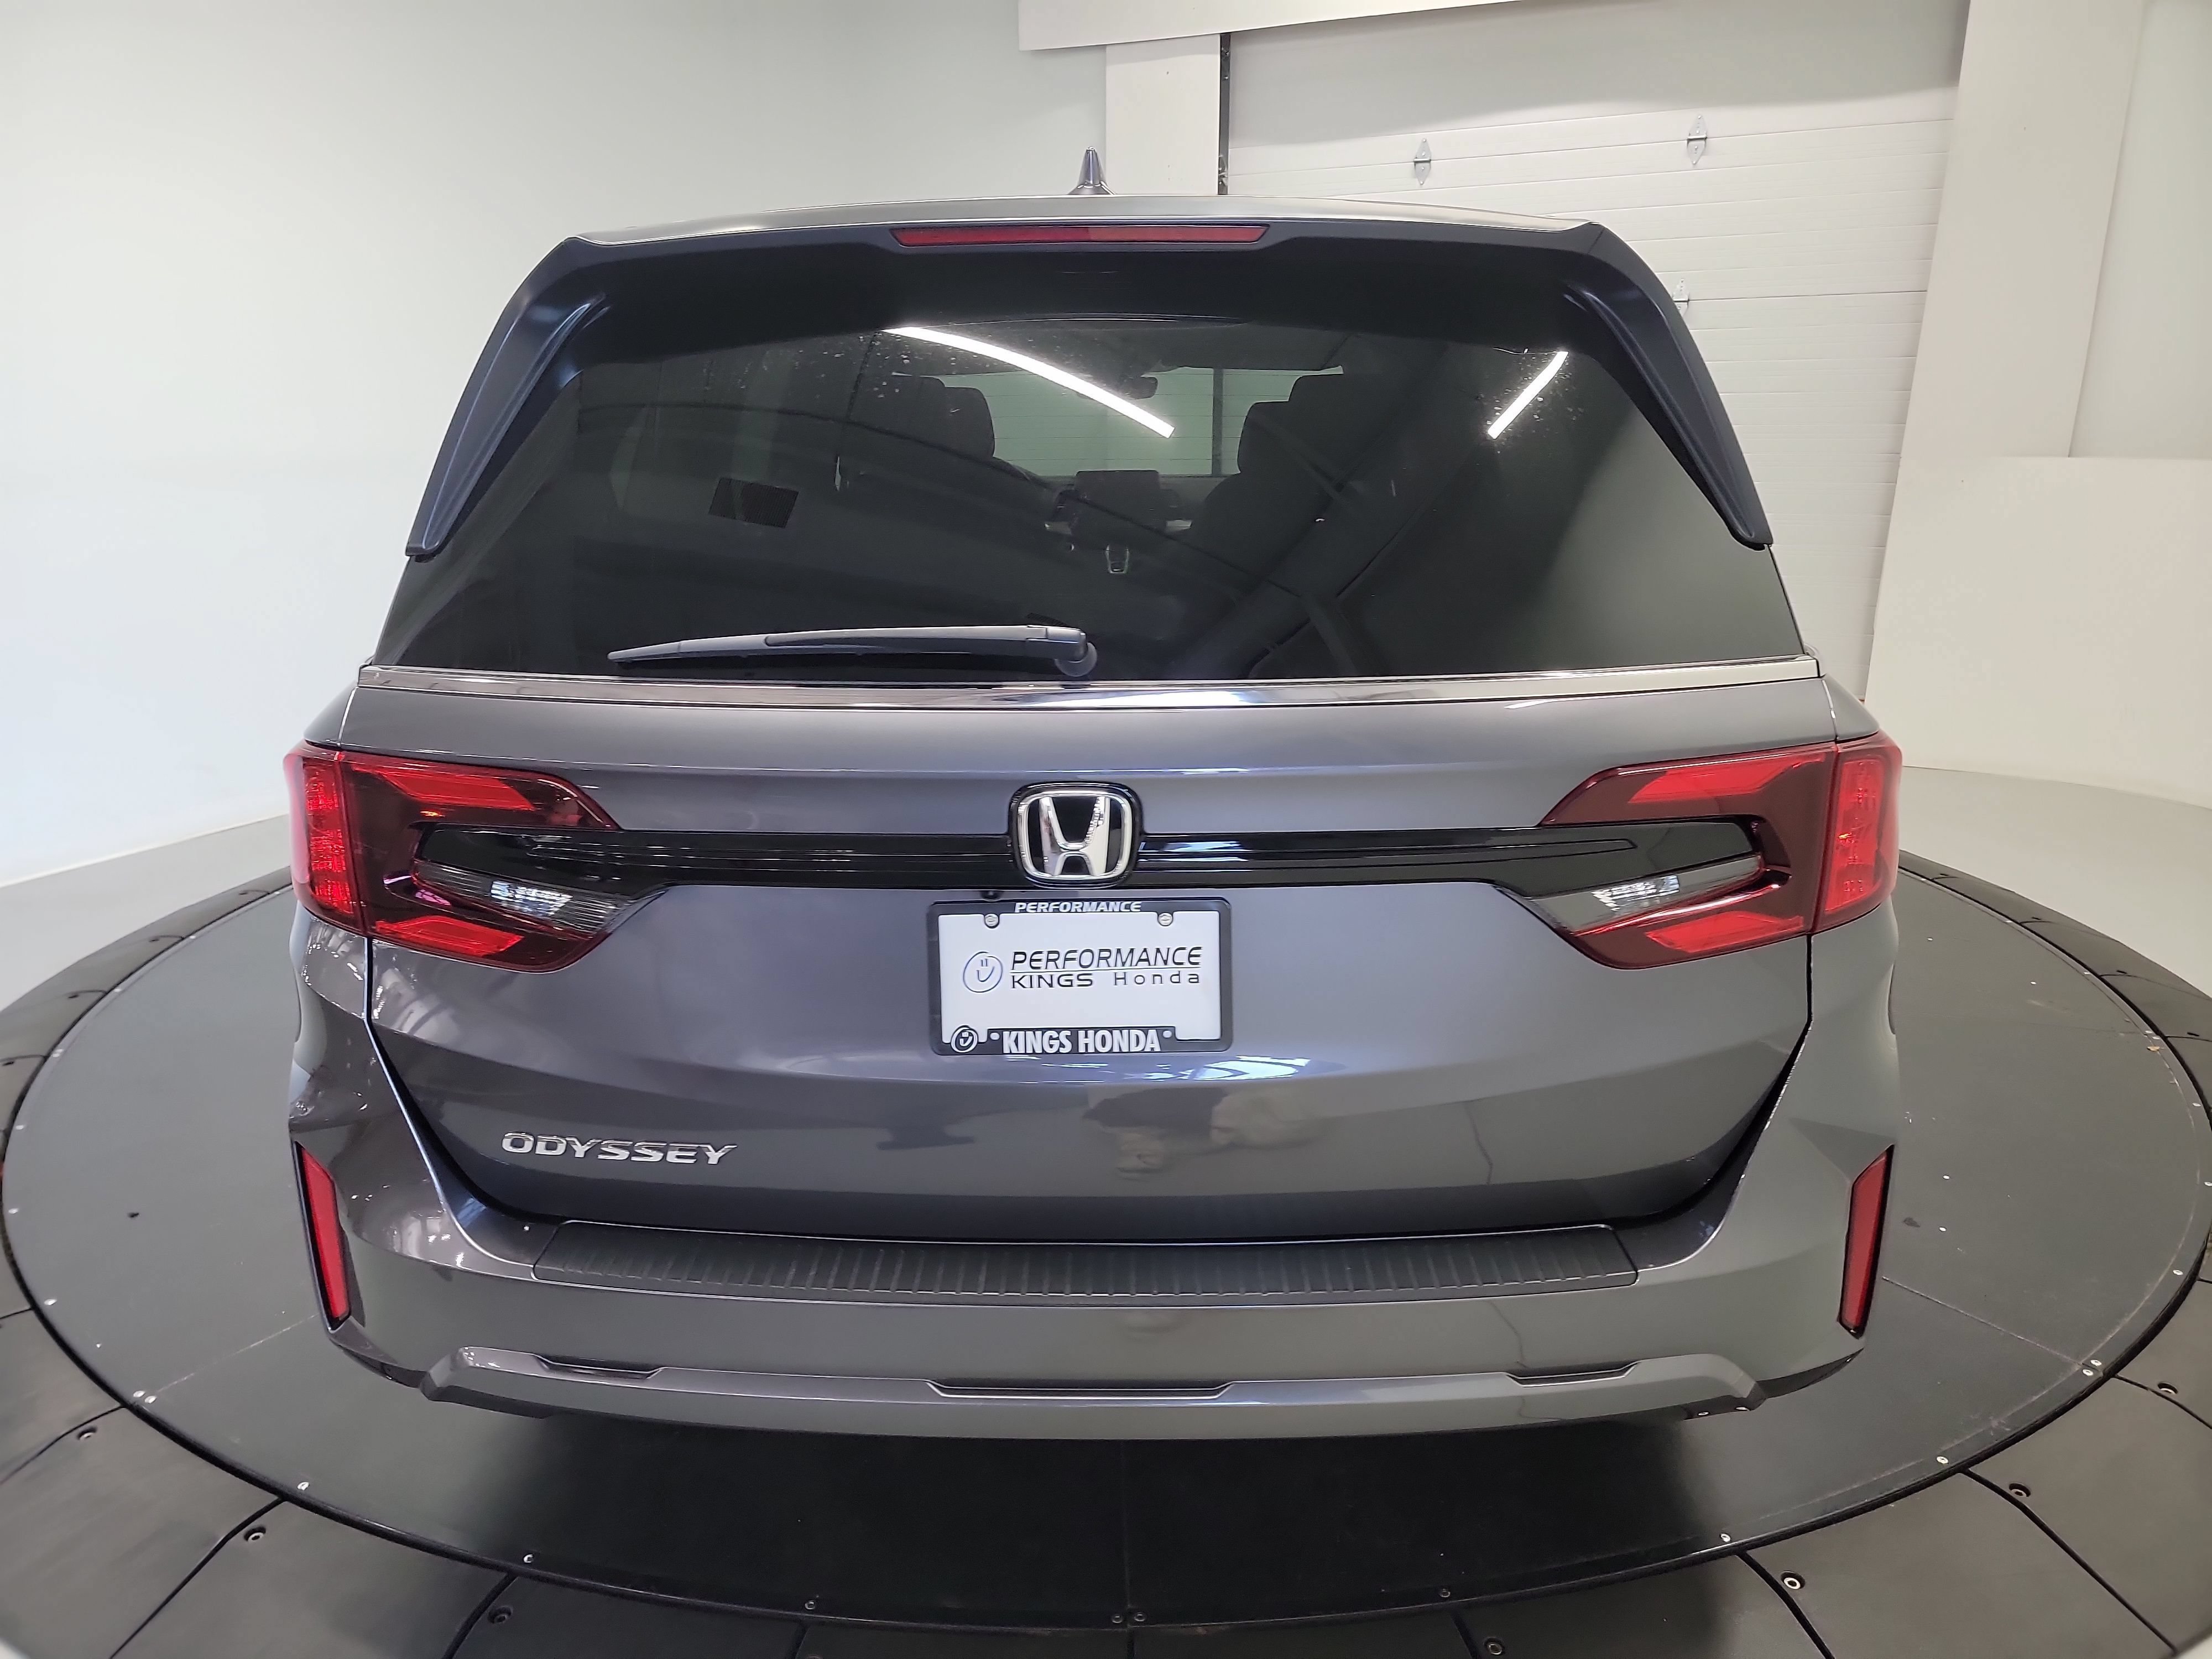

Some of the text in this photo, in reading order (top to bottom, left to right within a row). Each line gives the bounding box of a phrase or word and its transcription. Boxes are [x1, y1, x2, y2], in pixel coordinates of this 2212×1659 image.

[1015, 901, 1142, 913] PERFORMANCE
[1011, 946, 1203, 971] PERFORMANCE
[1011, 971, 1200, 989] KINGS Honda
[1002, 1029, 1161, 1054] KINGS HONDA
[502, 1131, 738, 1165] ODYSSEY
